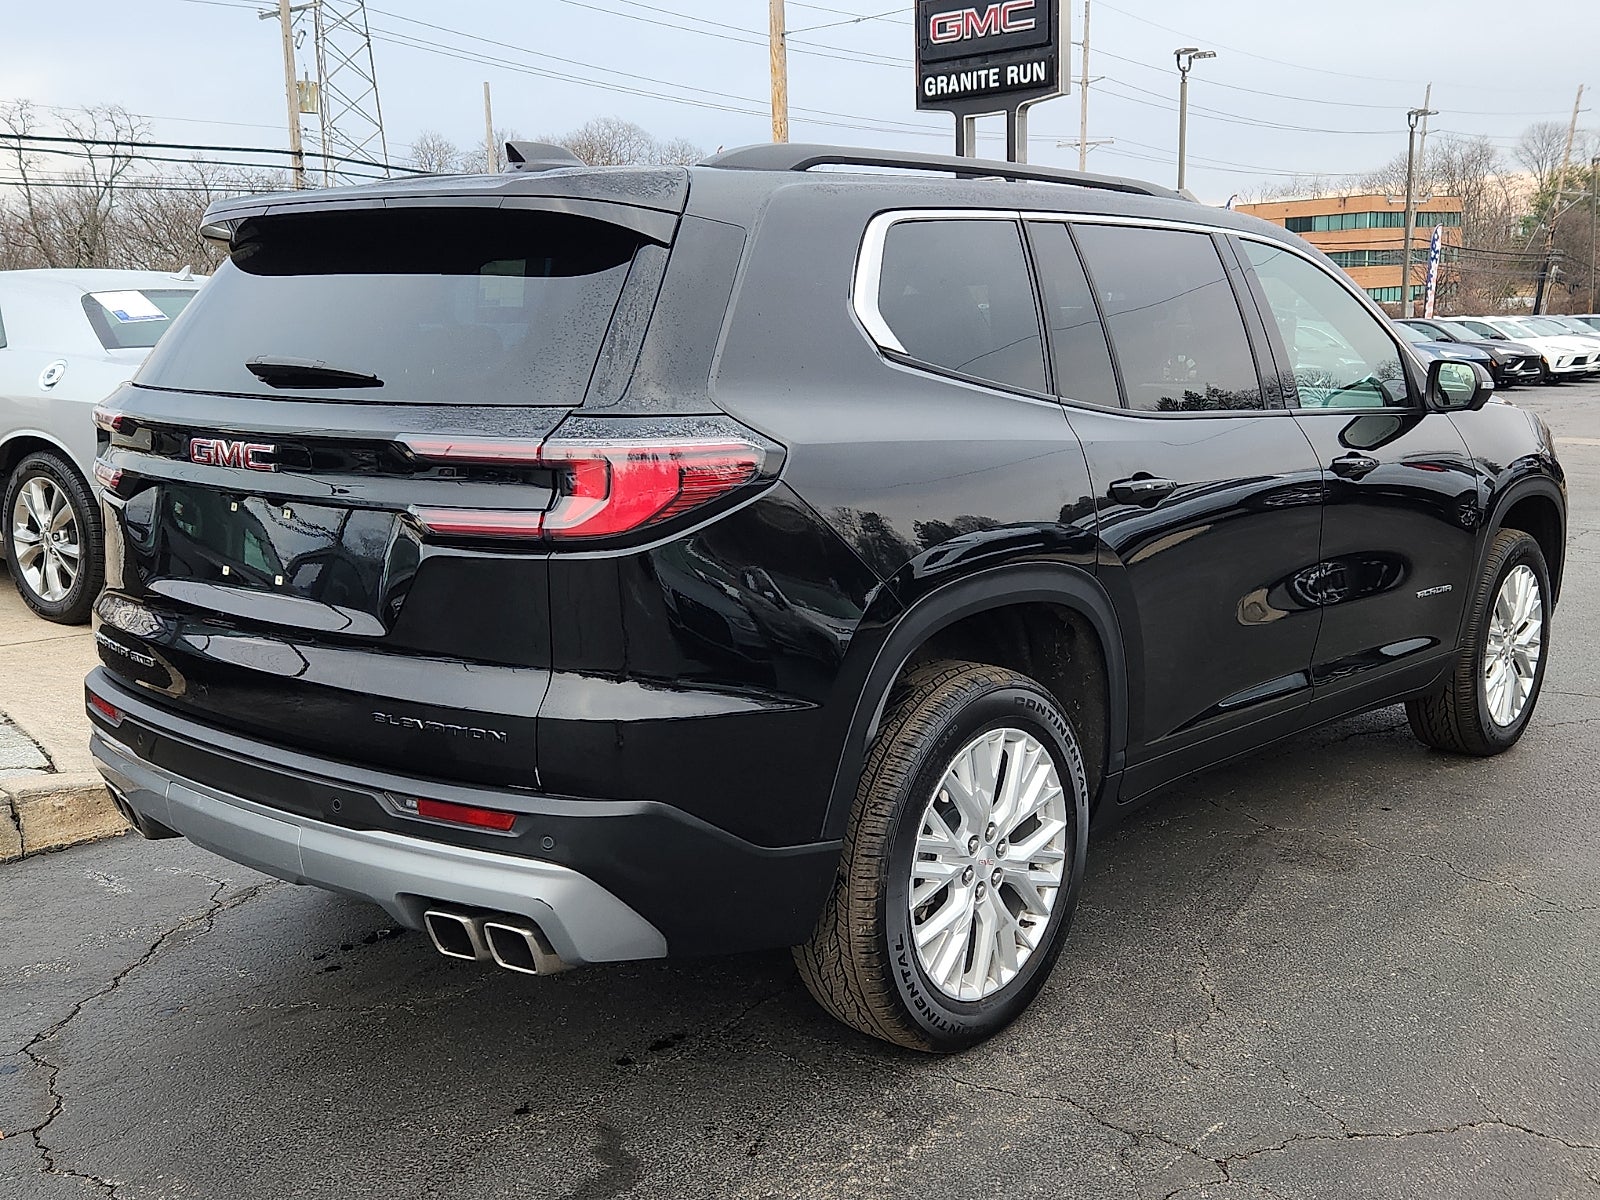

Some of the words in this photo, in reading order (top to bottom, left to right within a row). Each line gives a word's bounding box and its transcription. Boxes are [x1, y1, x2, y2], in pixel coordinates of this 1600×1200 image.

[929, 0, 1036, 44] GMC
[924, 68, 1000, 96] GRANITE
[1006, 61, 1046, 85] RUN
[190, 438, 277, 472] GMC
[1415, 584, 1453, 599] ACADIA
[371, 712, 507, 743] ELEVATION
[1013, 696, 1087, 807] CONTINENTAL
